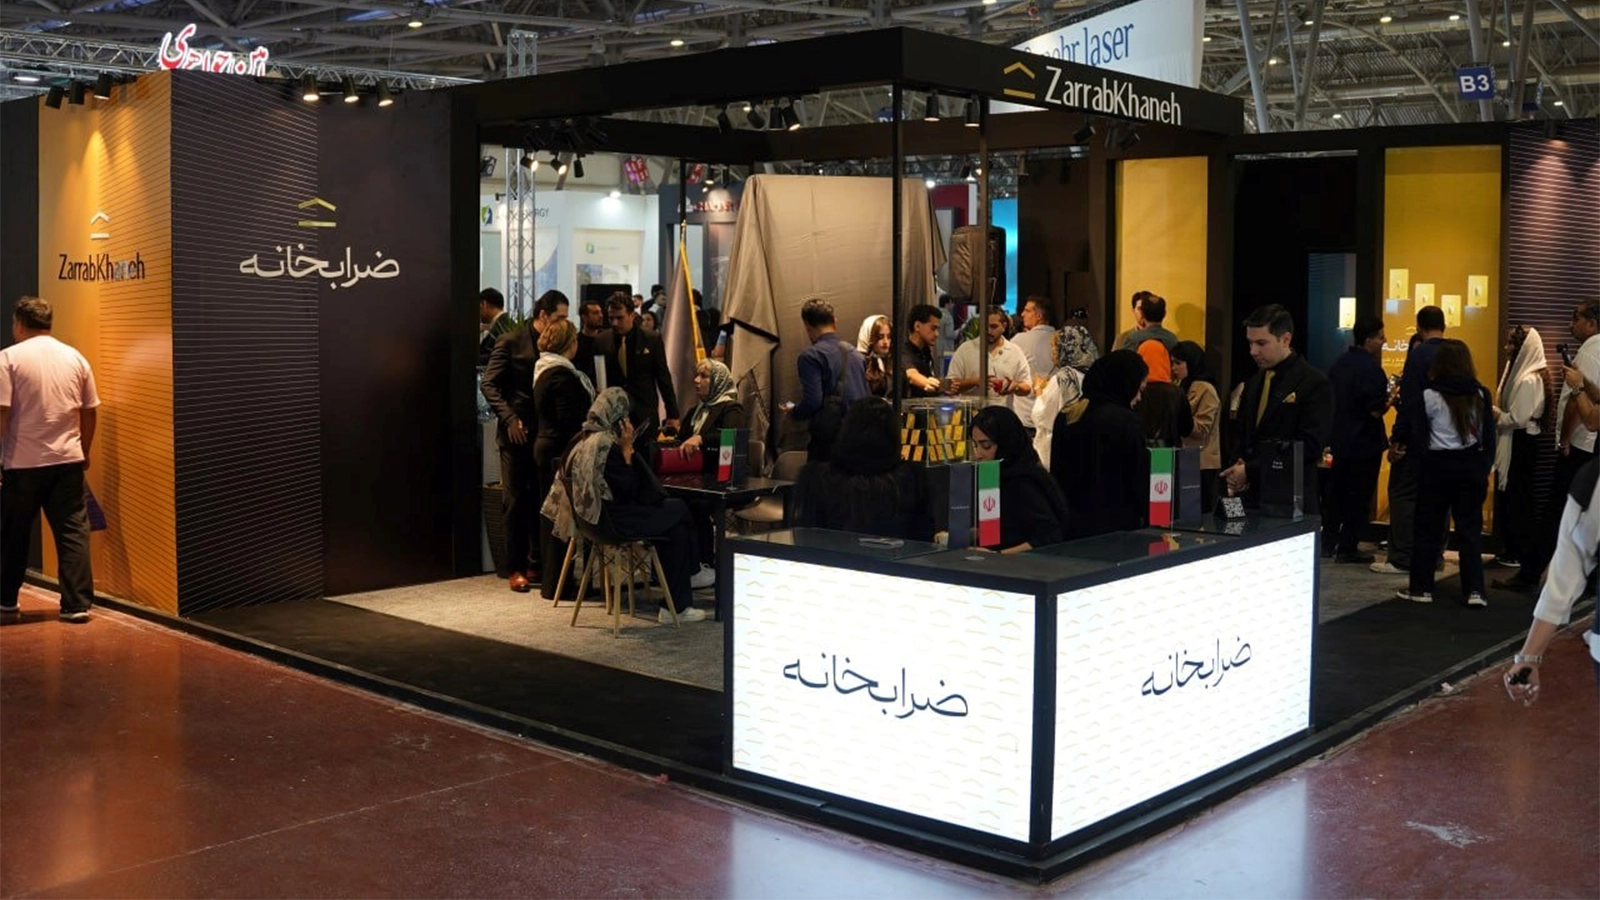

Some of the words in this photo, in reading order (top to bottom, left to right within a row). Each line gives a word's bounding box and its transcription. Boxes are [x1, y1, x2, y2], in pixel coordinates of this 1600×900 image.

[1083, 23, 1134, 67] laser
[1044, 65, 1182, 126] ZarrabKhaneh
[1459, 74, 1490, 93] B3
[239, 243, 400, 290] ضرابخانه
[782, 653, 969, 719] ضرابخانه
[1141, 637, 1252, 697] ضرابخانه
